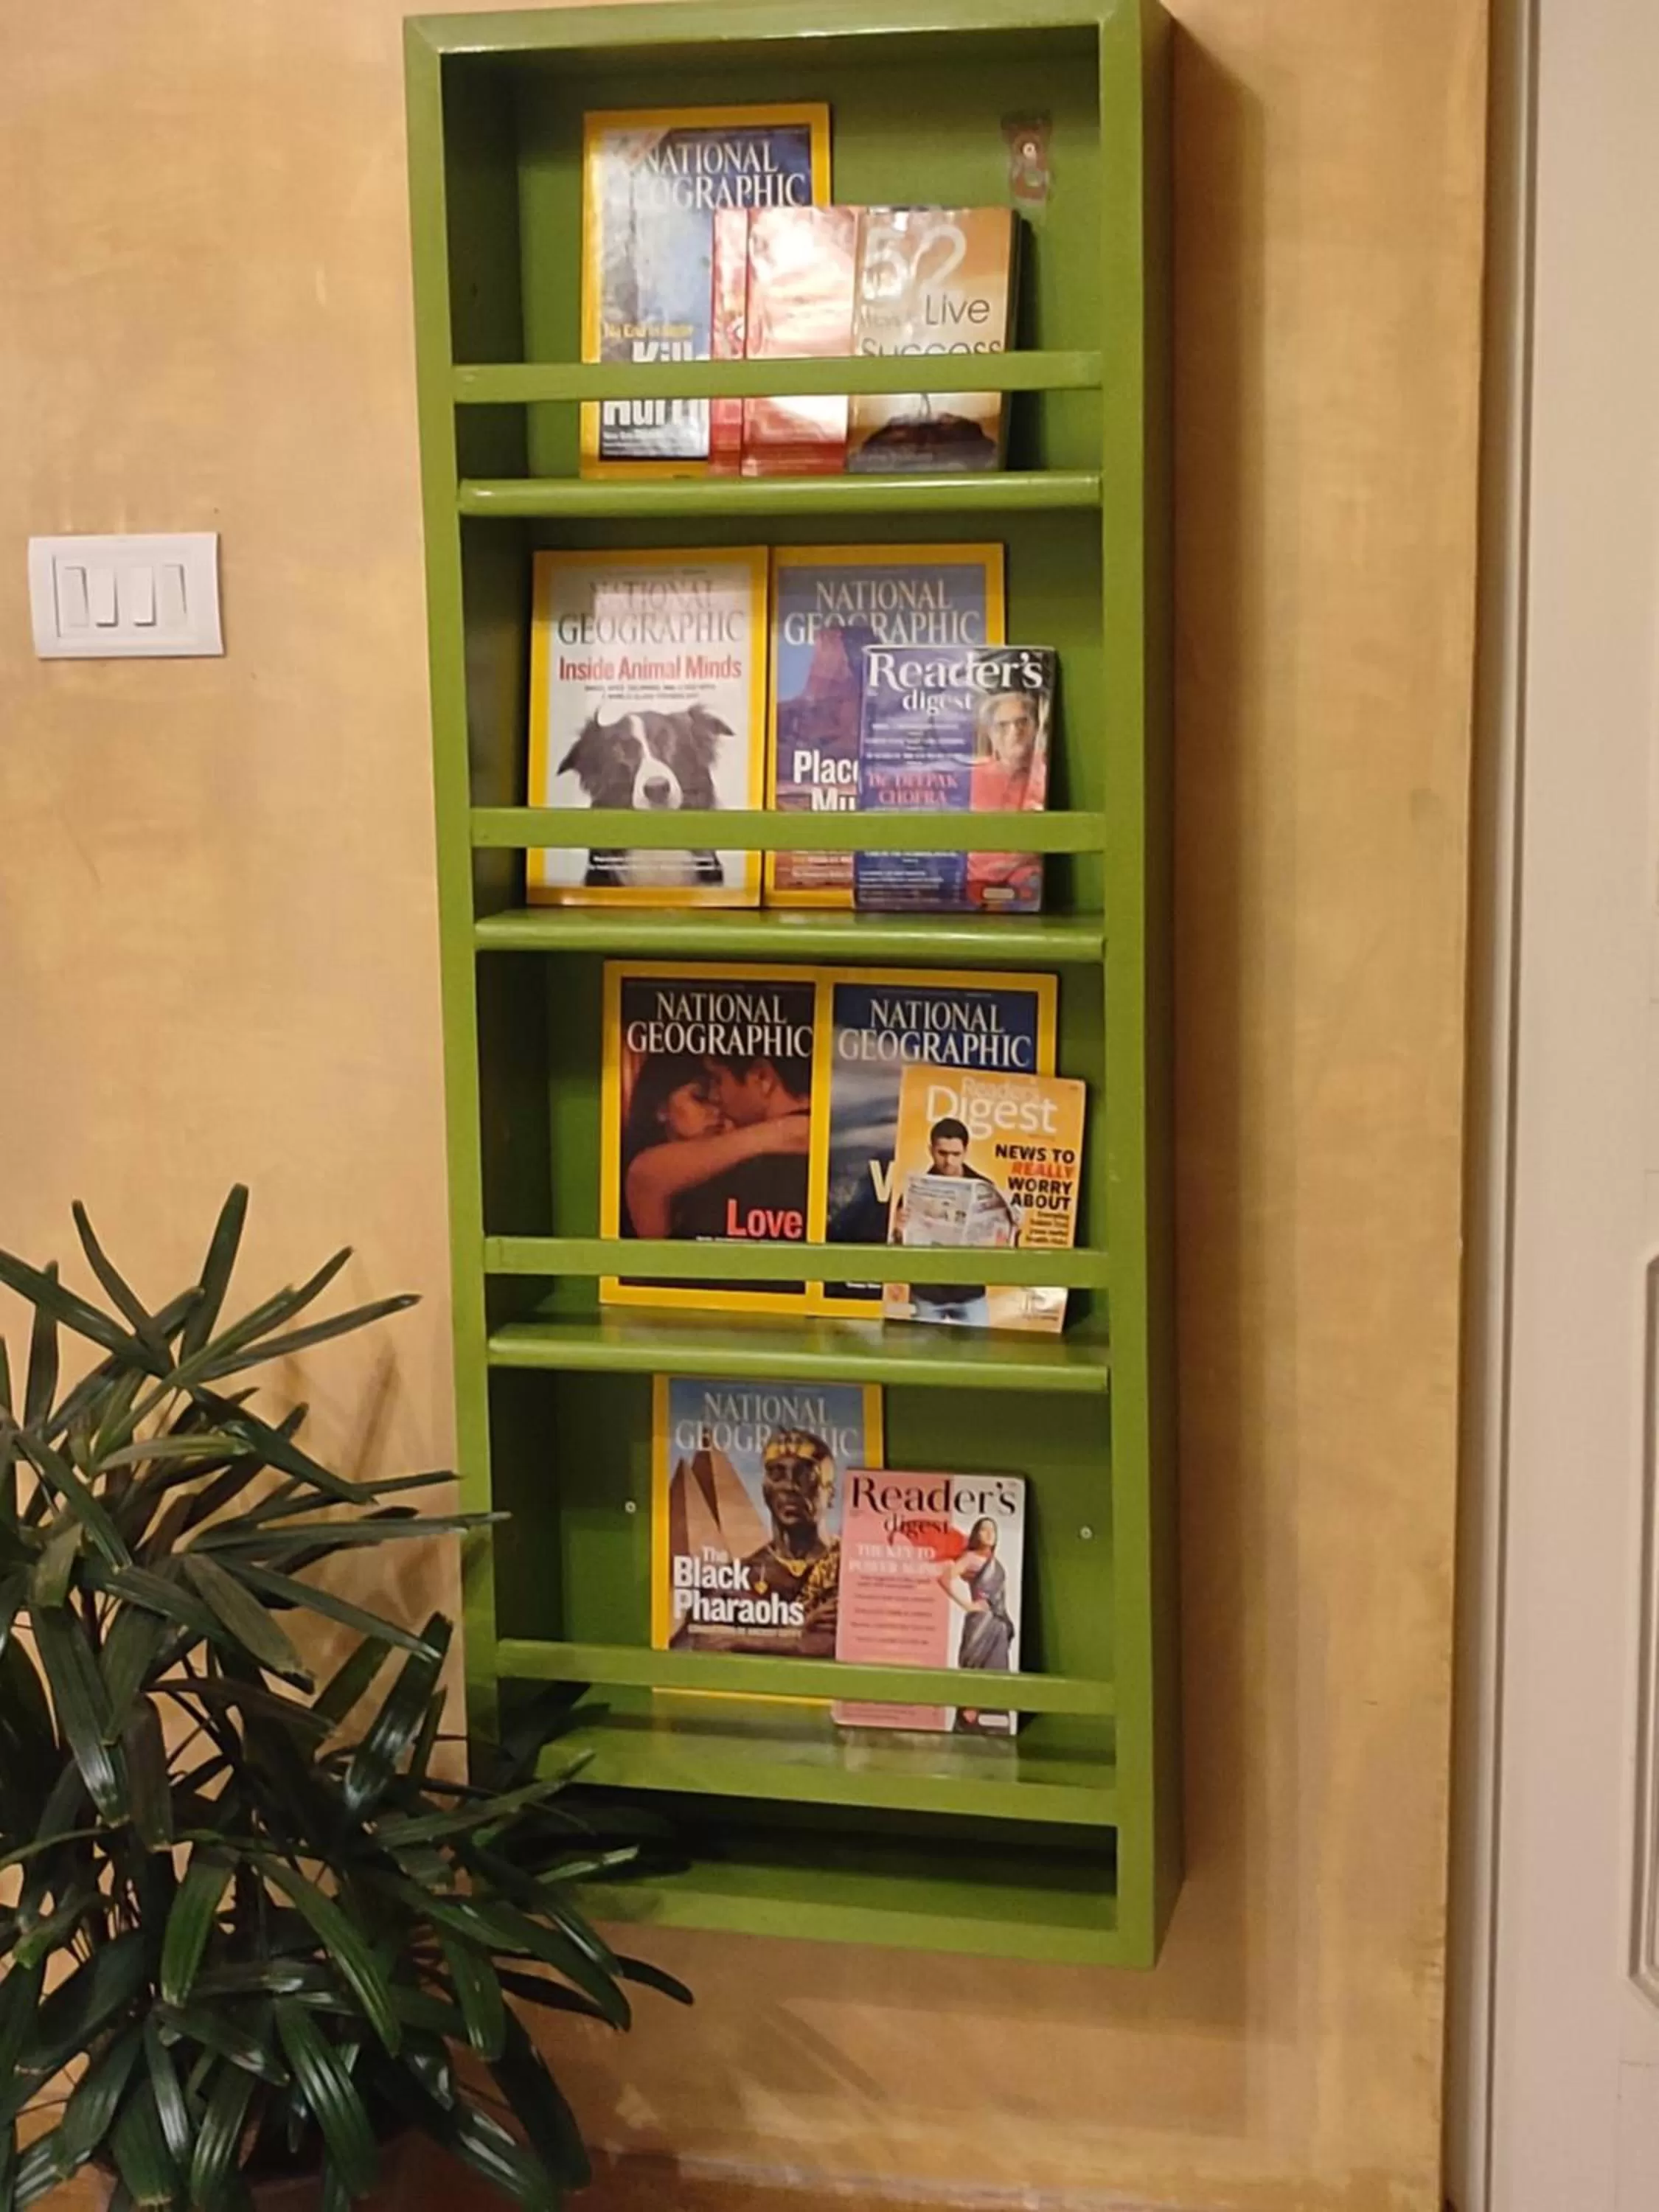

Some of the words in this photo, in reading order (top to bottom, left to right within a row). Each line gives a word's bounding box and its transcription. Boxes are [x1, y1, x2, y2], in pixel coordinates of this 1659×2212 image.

[643, 141, 779, 175] NATIONAL
[925, 293, 990, 326] Live
[815, 578, 952, 611] NATIONAL
[557, 611, 745, 645] GEOGRAPHIC
[559, 655, 614, 681] Inside
[619, 654, 681, 681] Animal
[685, 653, 742, 681] Minds
[869, 650, 1043, 692] Reader's
[902, 689, 973, 715] digest
[656, 991, 787, 1024] NATIONAL
[869, 998, 1005, 1033] NATIONAL
[626, 1020, 813, 1058] GEOGRAPHIC
[838, 1029, 1032, 1068] GEOGRAPHIC
[926, 1085, 1058, 1140] Digest
[995, 1144, 1046, 1161] NEWS
[1052, 1149, 1075, 1164] TO
[1011, 1161, 1074, 1178] REALLY
[1007, 1178, 1073, 1195] WORRY
[1010, 1192, 1071, 1211] ABOUT
[727, 1198, 803, 1238] Love
[704, 1392, 830, 1427] NATIONAL
[852, 1475, 1016, 1515] Reader's
[673, 1555, 751, 1590] Black
[673, 1588, 804, 1627] Pharaohs
